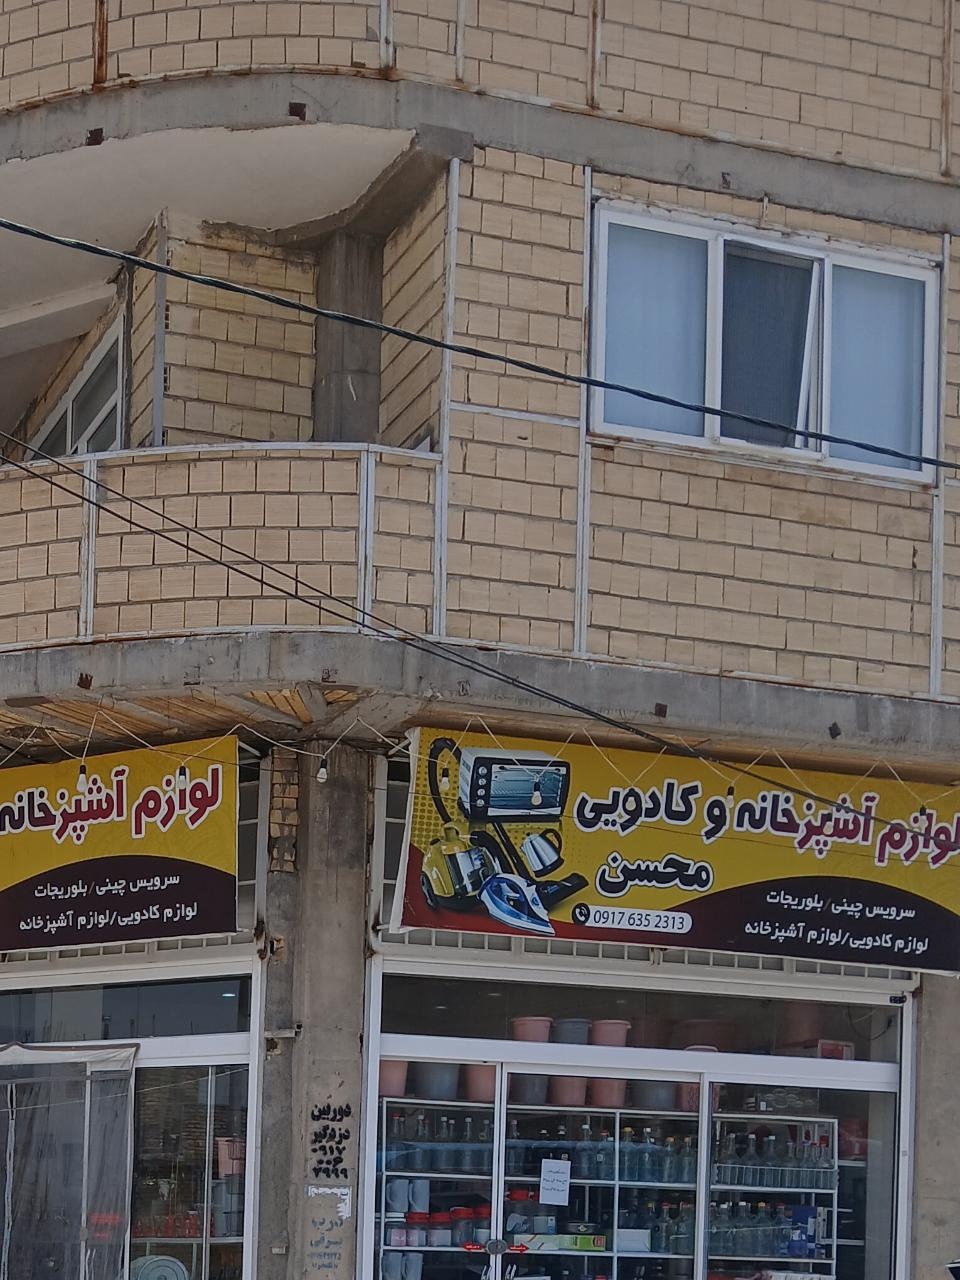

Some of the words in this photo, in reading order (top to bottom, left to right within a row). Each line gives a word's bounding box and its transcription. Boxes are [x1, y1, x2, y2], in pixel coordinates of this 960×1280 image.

[134, 767, 220, 836] لوازم
[576, 782, 700, 833] کادویی
[704, 798, 727, 840] و
[735, 793, 877, 855] آشپزخانه
[129, 875, 180, 892] سرویس
[597, 853, 712, 895] محسن
[19, 910, 74, 934] آشپزخانه
[163, 902, 198, 922] لوازم
[593, 909, 625, 925] 0917
[627, 912, 651, 927] 635
[654, 914, 685, 930] 2313
[865, 904, 916, 920] سرویس
[744, 920, 806, 943] آشپزخانه
[894, 937, 929, 954] لوازم
[311, 1103, 352, 1122] دوربین
